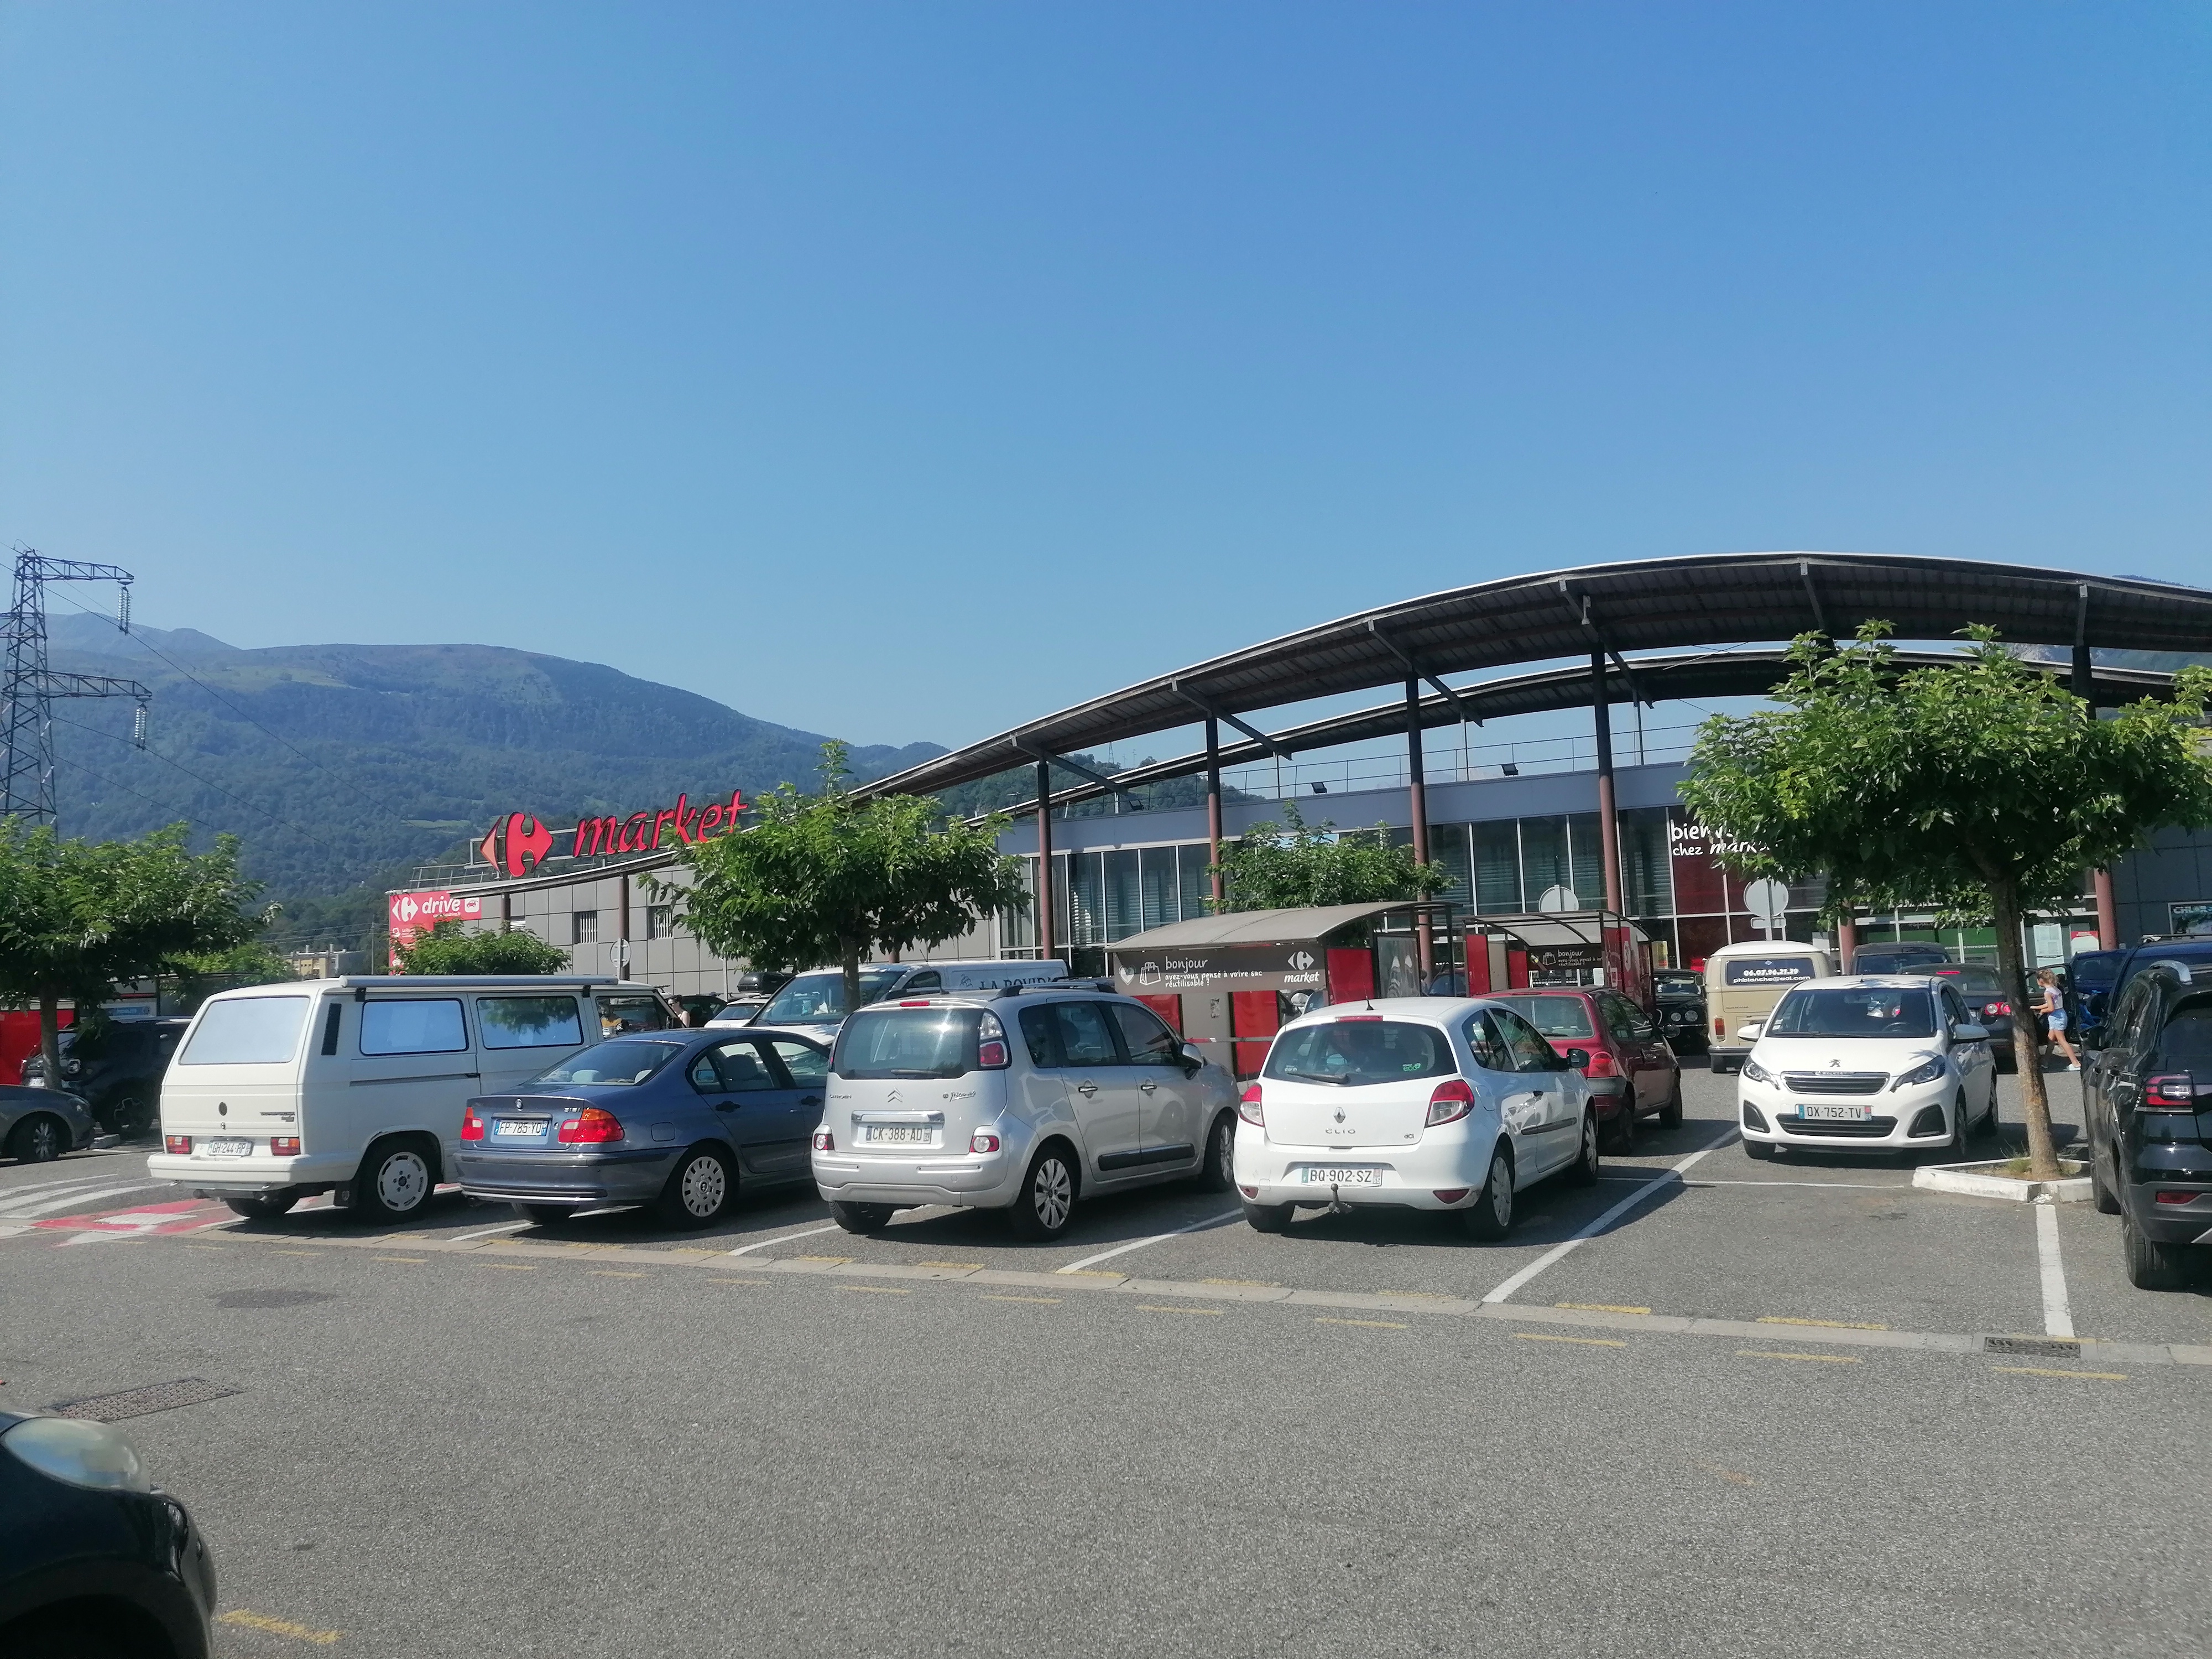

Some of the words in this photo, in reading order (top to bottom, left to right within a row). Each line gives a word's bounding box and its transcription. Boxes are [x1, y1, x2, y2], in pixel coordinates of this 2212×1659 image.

[572, 789, 749, 857] market
[1672, 842, 1704, 856] chez
[421, 895, 461, 914] drive
[1558, 949, 1584, 959] bonjour
[1165, 956, 1208, 973] bonjour
[1165, 978, 1204, 987] réutilisable
[1202, 972, 1221, 981] pensé
[1284, 971, 1320, 983] market
[1807, 1107, 1861, 1118] DX-752-TV
[873, 1127, 922, 1141] CK-388-AD
[1310, 1170, 1372, 1182] BQ-902-SZ
